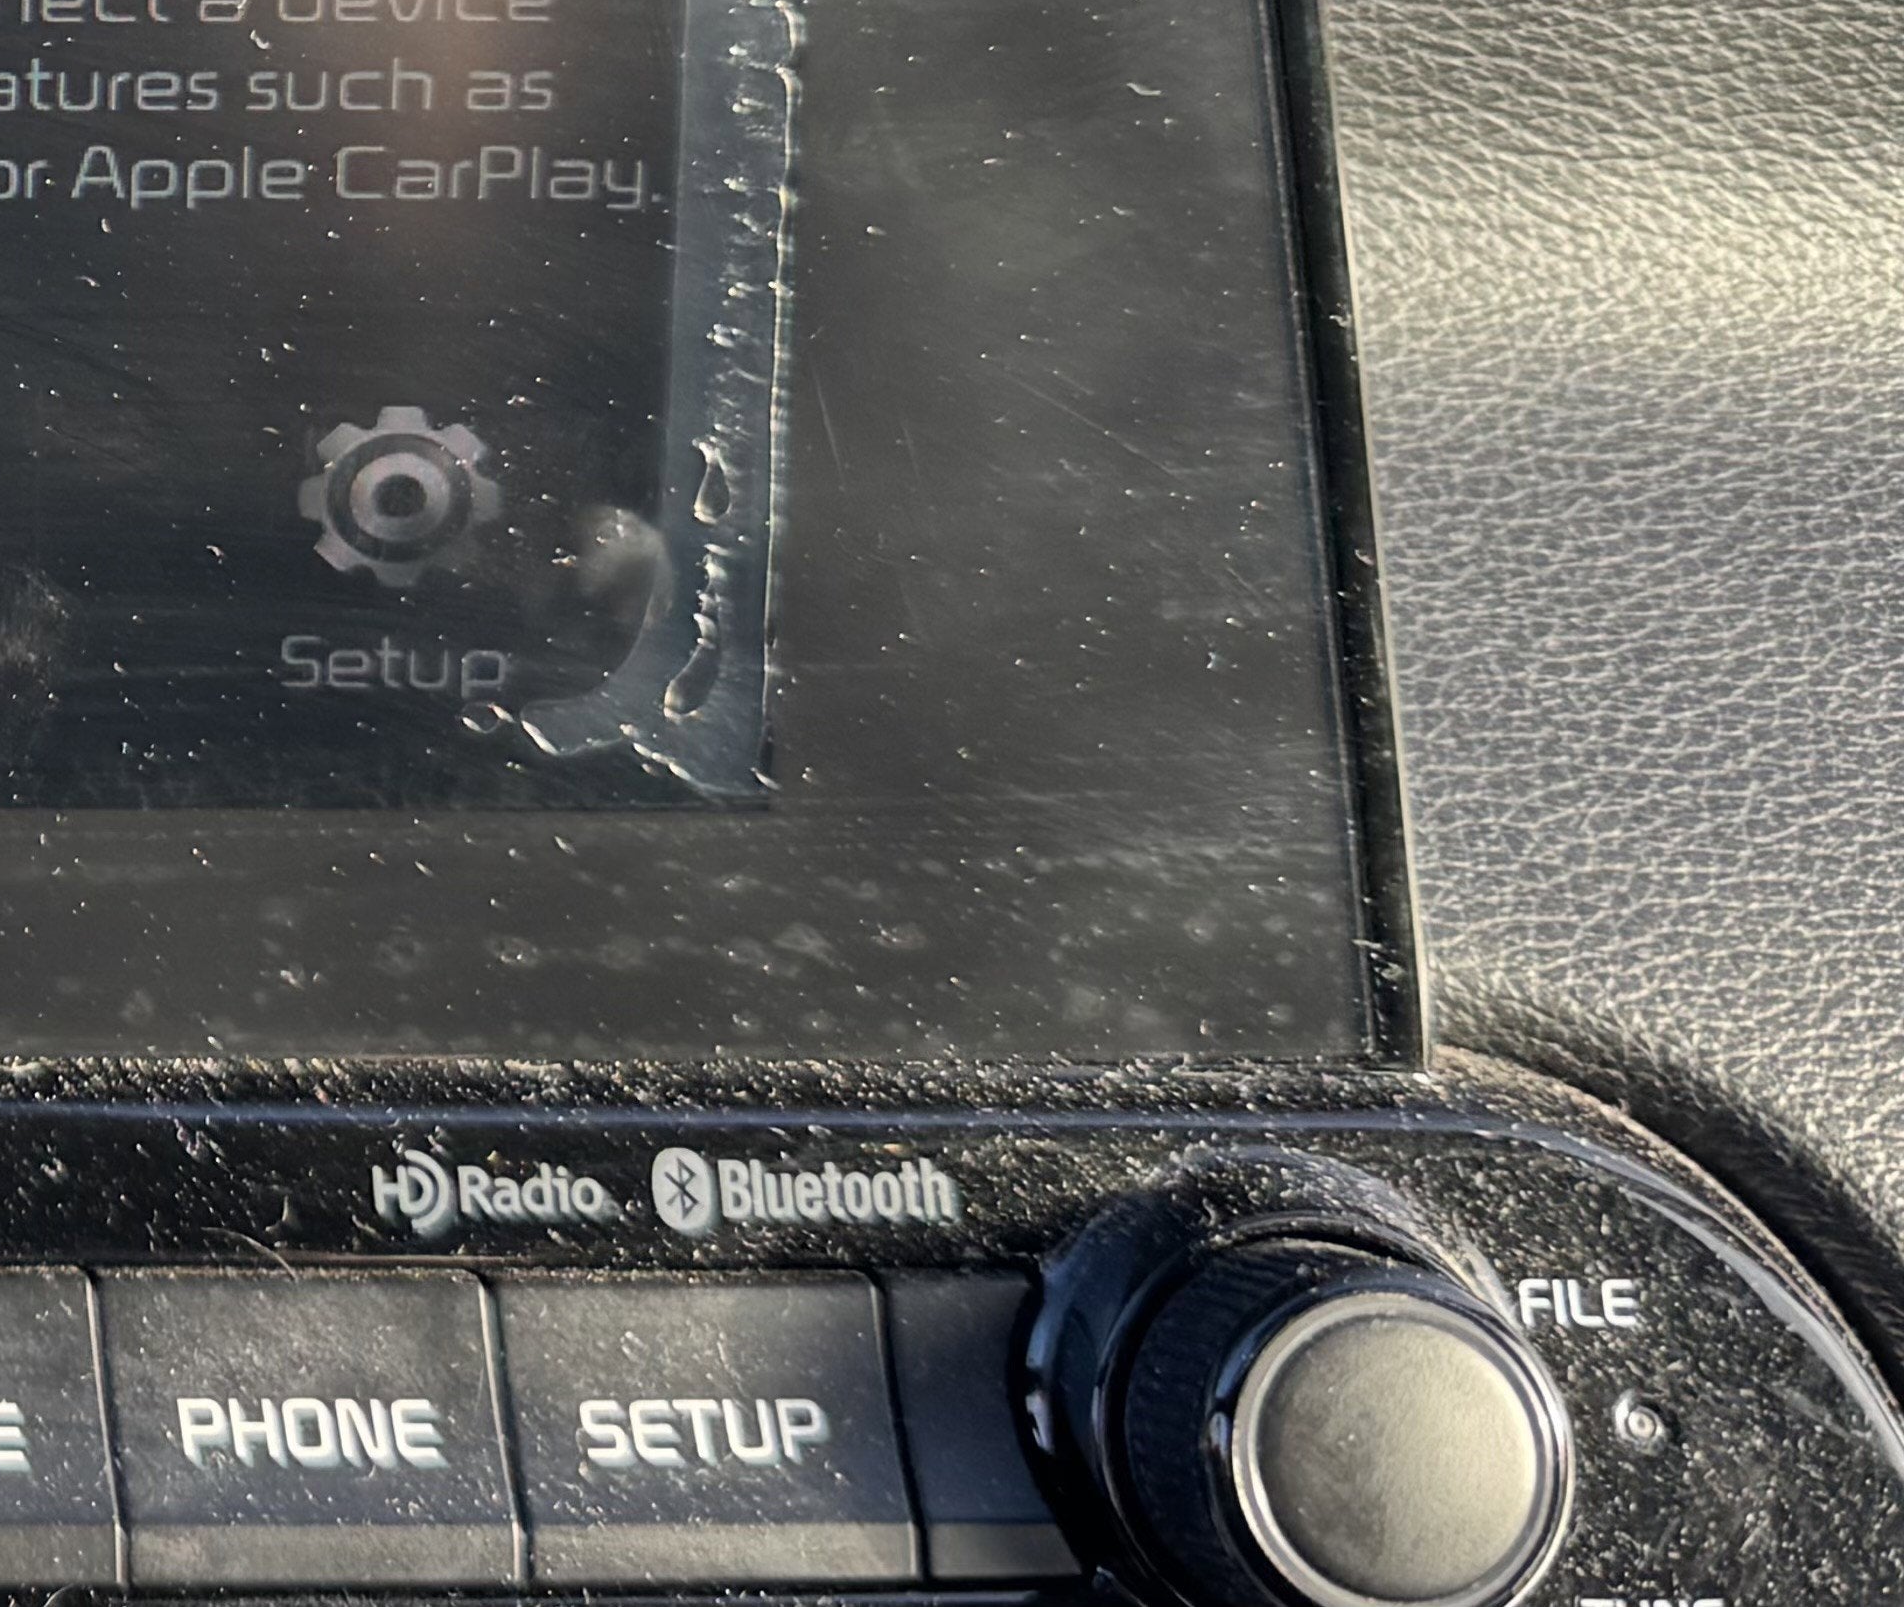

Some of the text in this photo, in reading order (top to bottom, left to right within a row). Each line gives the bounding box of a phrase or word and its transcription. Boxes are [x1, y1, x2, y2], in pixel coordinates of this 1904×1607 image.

[246, 58, 434, 116] such
[466, 68, 556, 116] as
[70, 144, 304, 214] Apple
[280, 634, 510, 698] Setup
[458, 1164, 604, 1222] Radio
[718, 1158, 958, 1226] Bluetooth
[1518, 1278, 1637, 1328] FILE
[178, 1398, 446, 1470] PHONE
[580, 1400, 828, 1470] SETUP
